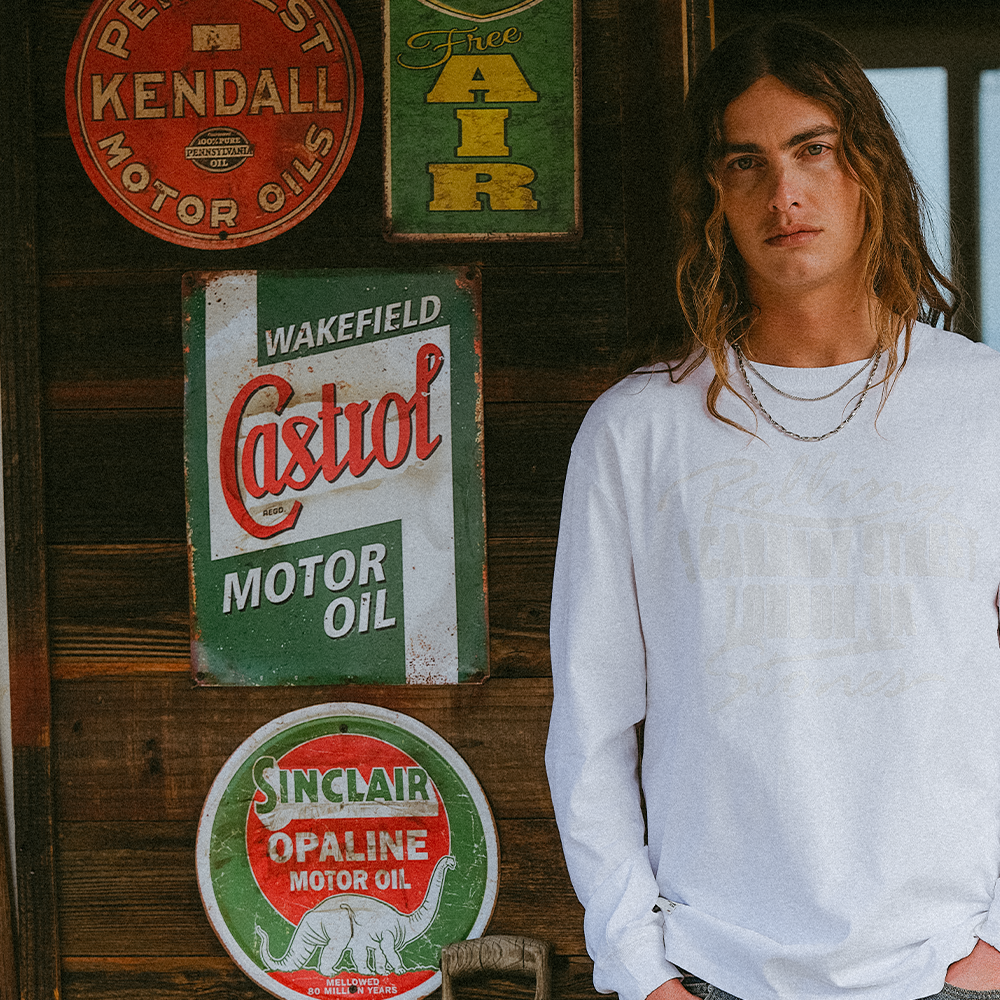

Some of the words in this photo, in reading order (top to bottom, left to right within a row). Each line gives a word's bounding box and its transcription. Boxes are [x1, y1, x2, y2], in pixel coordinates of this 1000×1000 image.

[396, 26, 523, 69] Free
[91, 66, 342, 121] KENDALL
[424, 54, 539, 211] AIR
[97, 131, 239, 229] MOTOR
[256, 123, 335, 214] OILS
[210, 159, 228, 167] OIL
[264, 294, 442, 358] WAKEFIELD
[219, 342, 445, 540] Castrol
[222, 543, 387, 614] MOTOR
[323, 588, 396, 640] OIL
[253, 756, 431, 814] SINCLAIR
[267, 829, 429, 864] OPALINE
[289, 869, 369, 892] MOTOR
[374, 867, 412, 890] OIL
[308, 987, 320, 995] 80
[324, 987, 364, 995] MILLIN
[367, 986, 398, 994] YEARS
[326, 978, 380, 986] MELLOWED
